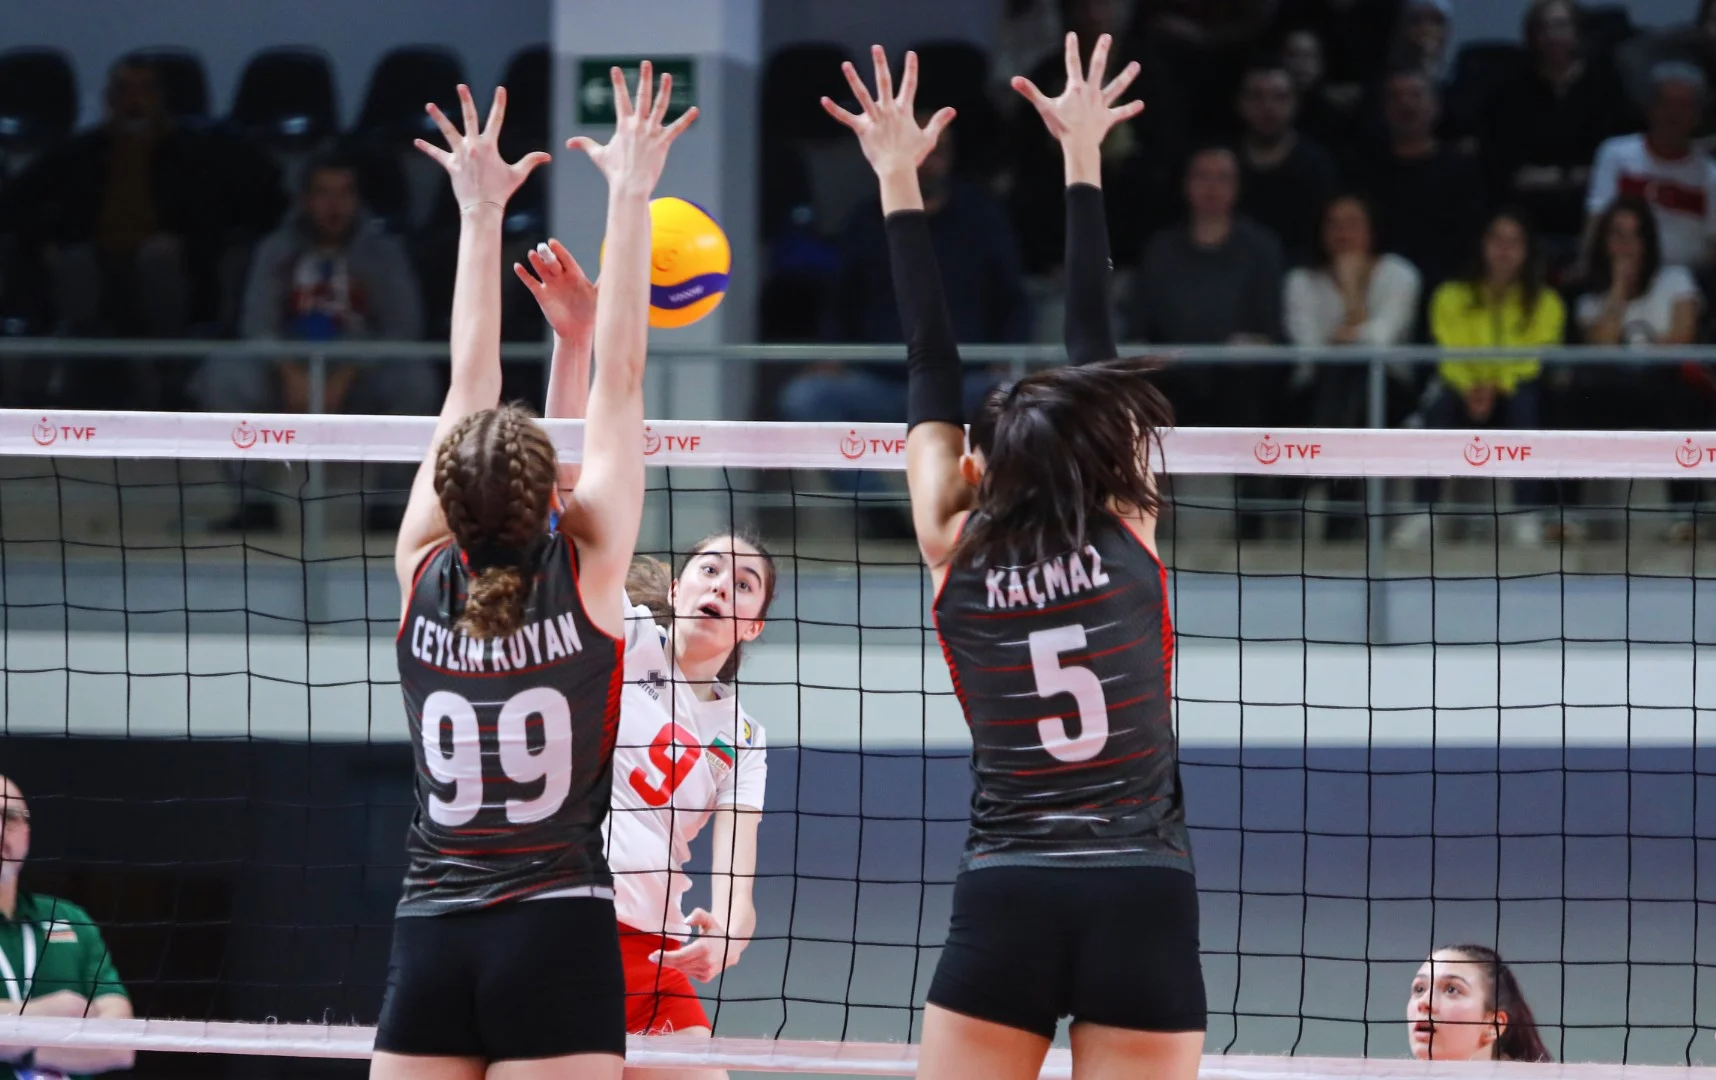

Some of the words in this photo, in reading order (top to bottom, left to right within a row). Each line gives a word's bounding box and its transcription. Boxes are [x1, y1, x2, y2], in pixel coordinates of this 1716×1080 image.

[61, 426, 96, 441] TVF
[260, 429, 296, 444] TVF
[665, 435, 701, 452] TVF
[869, 439, 906, 454] TVF
[1284, 443, 1321, 460] TVF
[1494, 445, 1532, 461] TVF
[985, 545, 1110, 609] KAÇMAZ
[491, 612, 583, 672] KUYAN
[1028, 624, 1109, 762] 5
[421, 686, 573, 826] 99
[628, 721, 702, 807] 9
